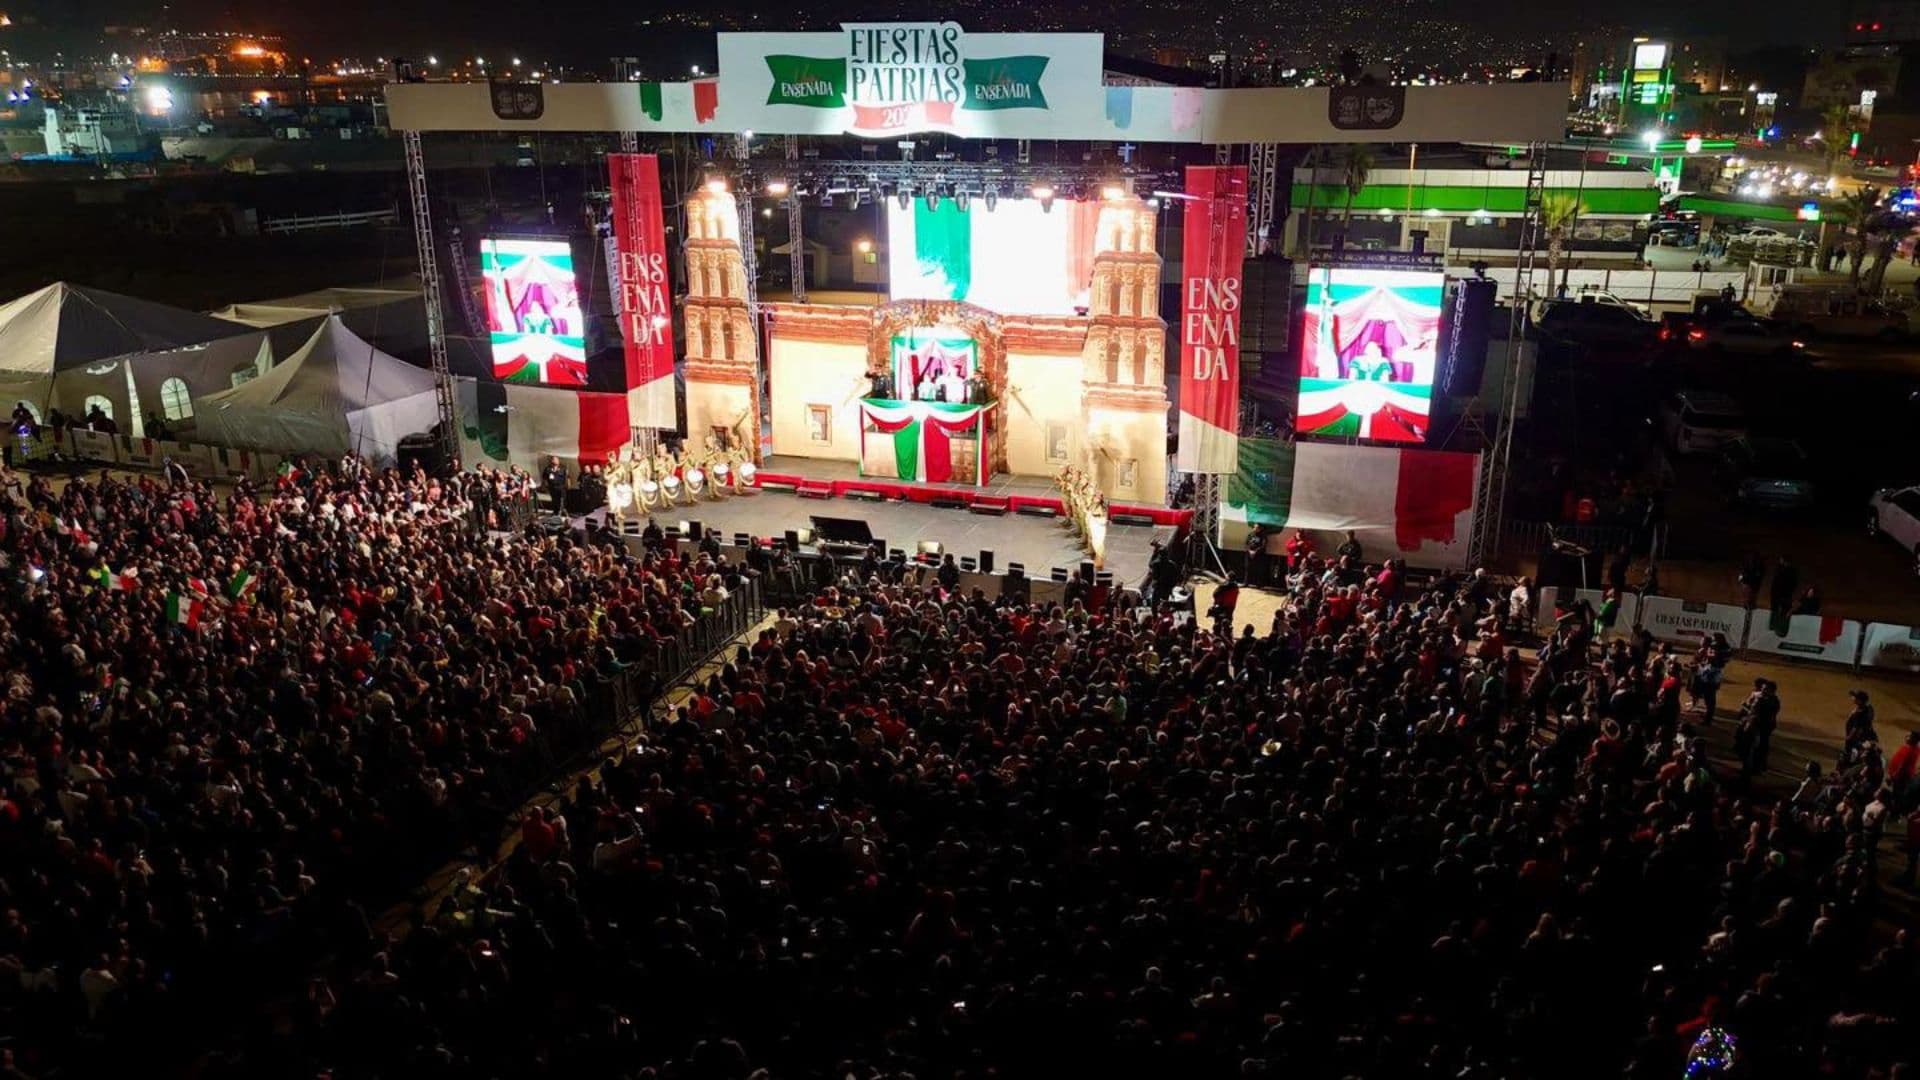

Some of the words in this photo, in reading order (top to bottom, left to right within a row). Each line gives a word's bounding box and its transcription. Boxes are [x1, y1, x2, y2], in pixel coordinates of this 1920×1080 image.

[851, 28, 959, 65] FIESTAS
[781, 80, 834, 97] ENSENADA
[851, 66, 960, 104] PATRIAS
[975, 82, 1031, 101] ENSENADA
[621, 252, 665, 283] ENS
[623, 284, 666, 315] ENA
[1188, 276, 1239, 312] ENS
[632, 313, 665, 345] DA
[1186, 313, 1236, 345] ENA
[1193, 346, 1229, 381] DA
